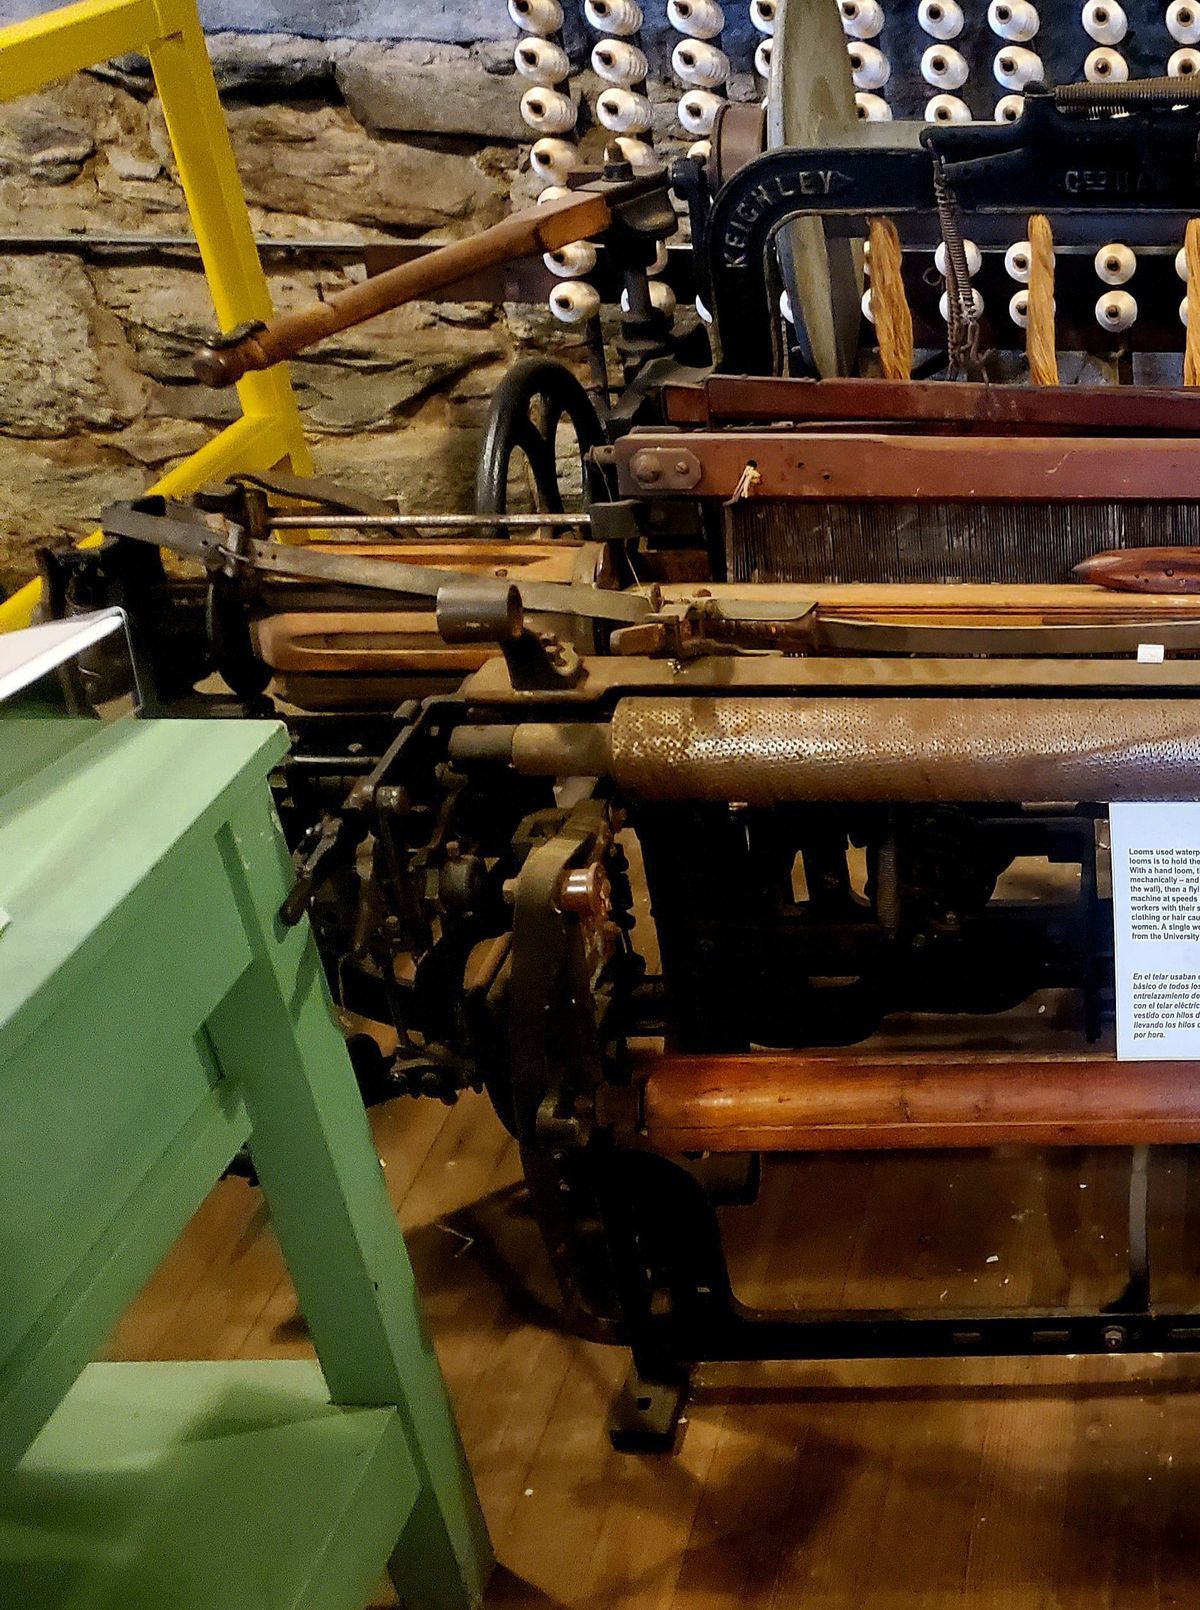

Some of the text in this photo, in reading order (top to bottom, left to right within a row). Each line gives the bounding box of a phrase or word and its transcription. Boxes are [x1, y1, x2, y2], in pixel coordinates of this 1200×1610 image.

[723, 170, 834, 268] KEIGHLEY
[1129, 857, 1152, 865] looms
[1153, 857, 1160, 865] is
[1161, 857, 1169, 865] to
[1129, 866, 1146, 874] With
[1174, 867, 1195, 875] loom,
[1130, 885, 1142, 893] the
[1143, 886, 1162, 895] wall),
[1131, 914, 1160, 923] clothing
[1168, 923, 1190, 932] single
[1131, 932, 1148, 940] from
[1150, 932, 1162, 940] the
[1163, 932, 1200, 942] University
[1158, 982, 1167, 990] de
[1169, 982, 1189, 990] todos
[1134, 1032, 1146, 1040] por
